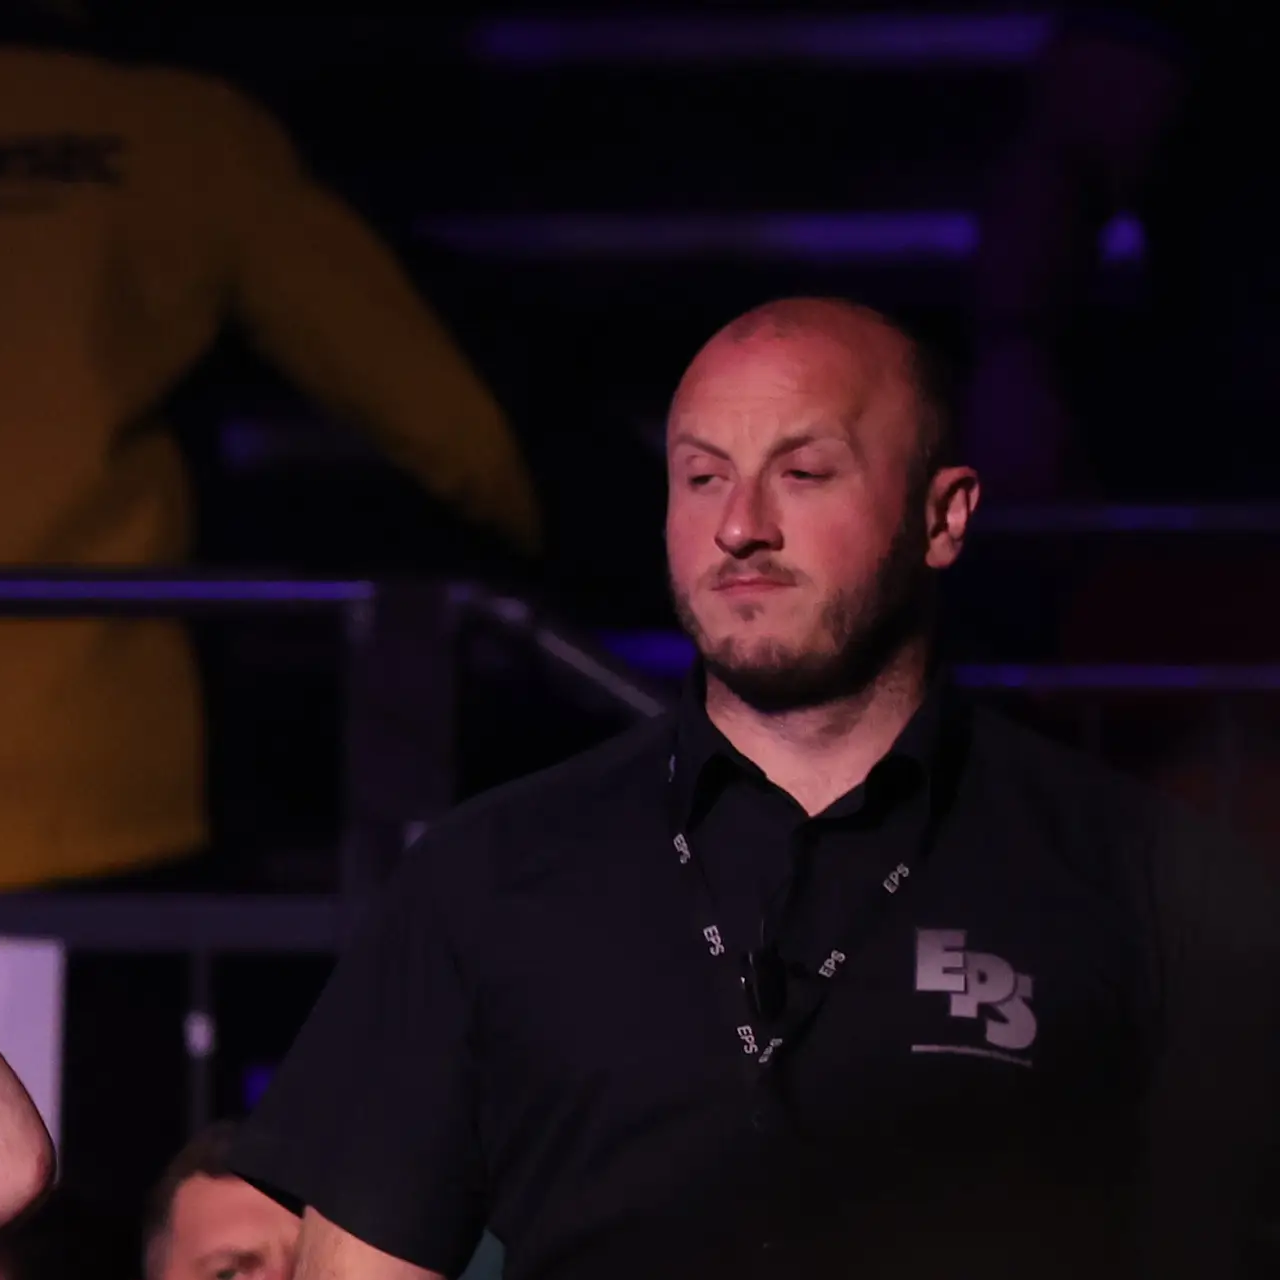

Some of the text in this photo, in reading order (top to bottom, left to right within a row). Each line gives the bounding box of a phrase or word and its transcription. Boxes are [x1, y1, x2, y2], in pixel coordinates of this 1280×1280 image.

[881, 862, 910, 894] EPS
[703, 924, 725, 957] EPS
[818, 948, 846, 979] EPS
[914, 928, 1038, 1050] EPS
[736, 1024, 759, 1055] EPS
